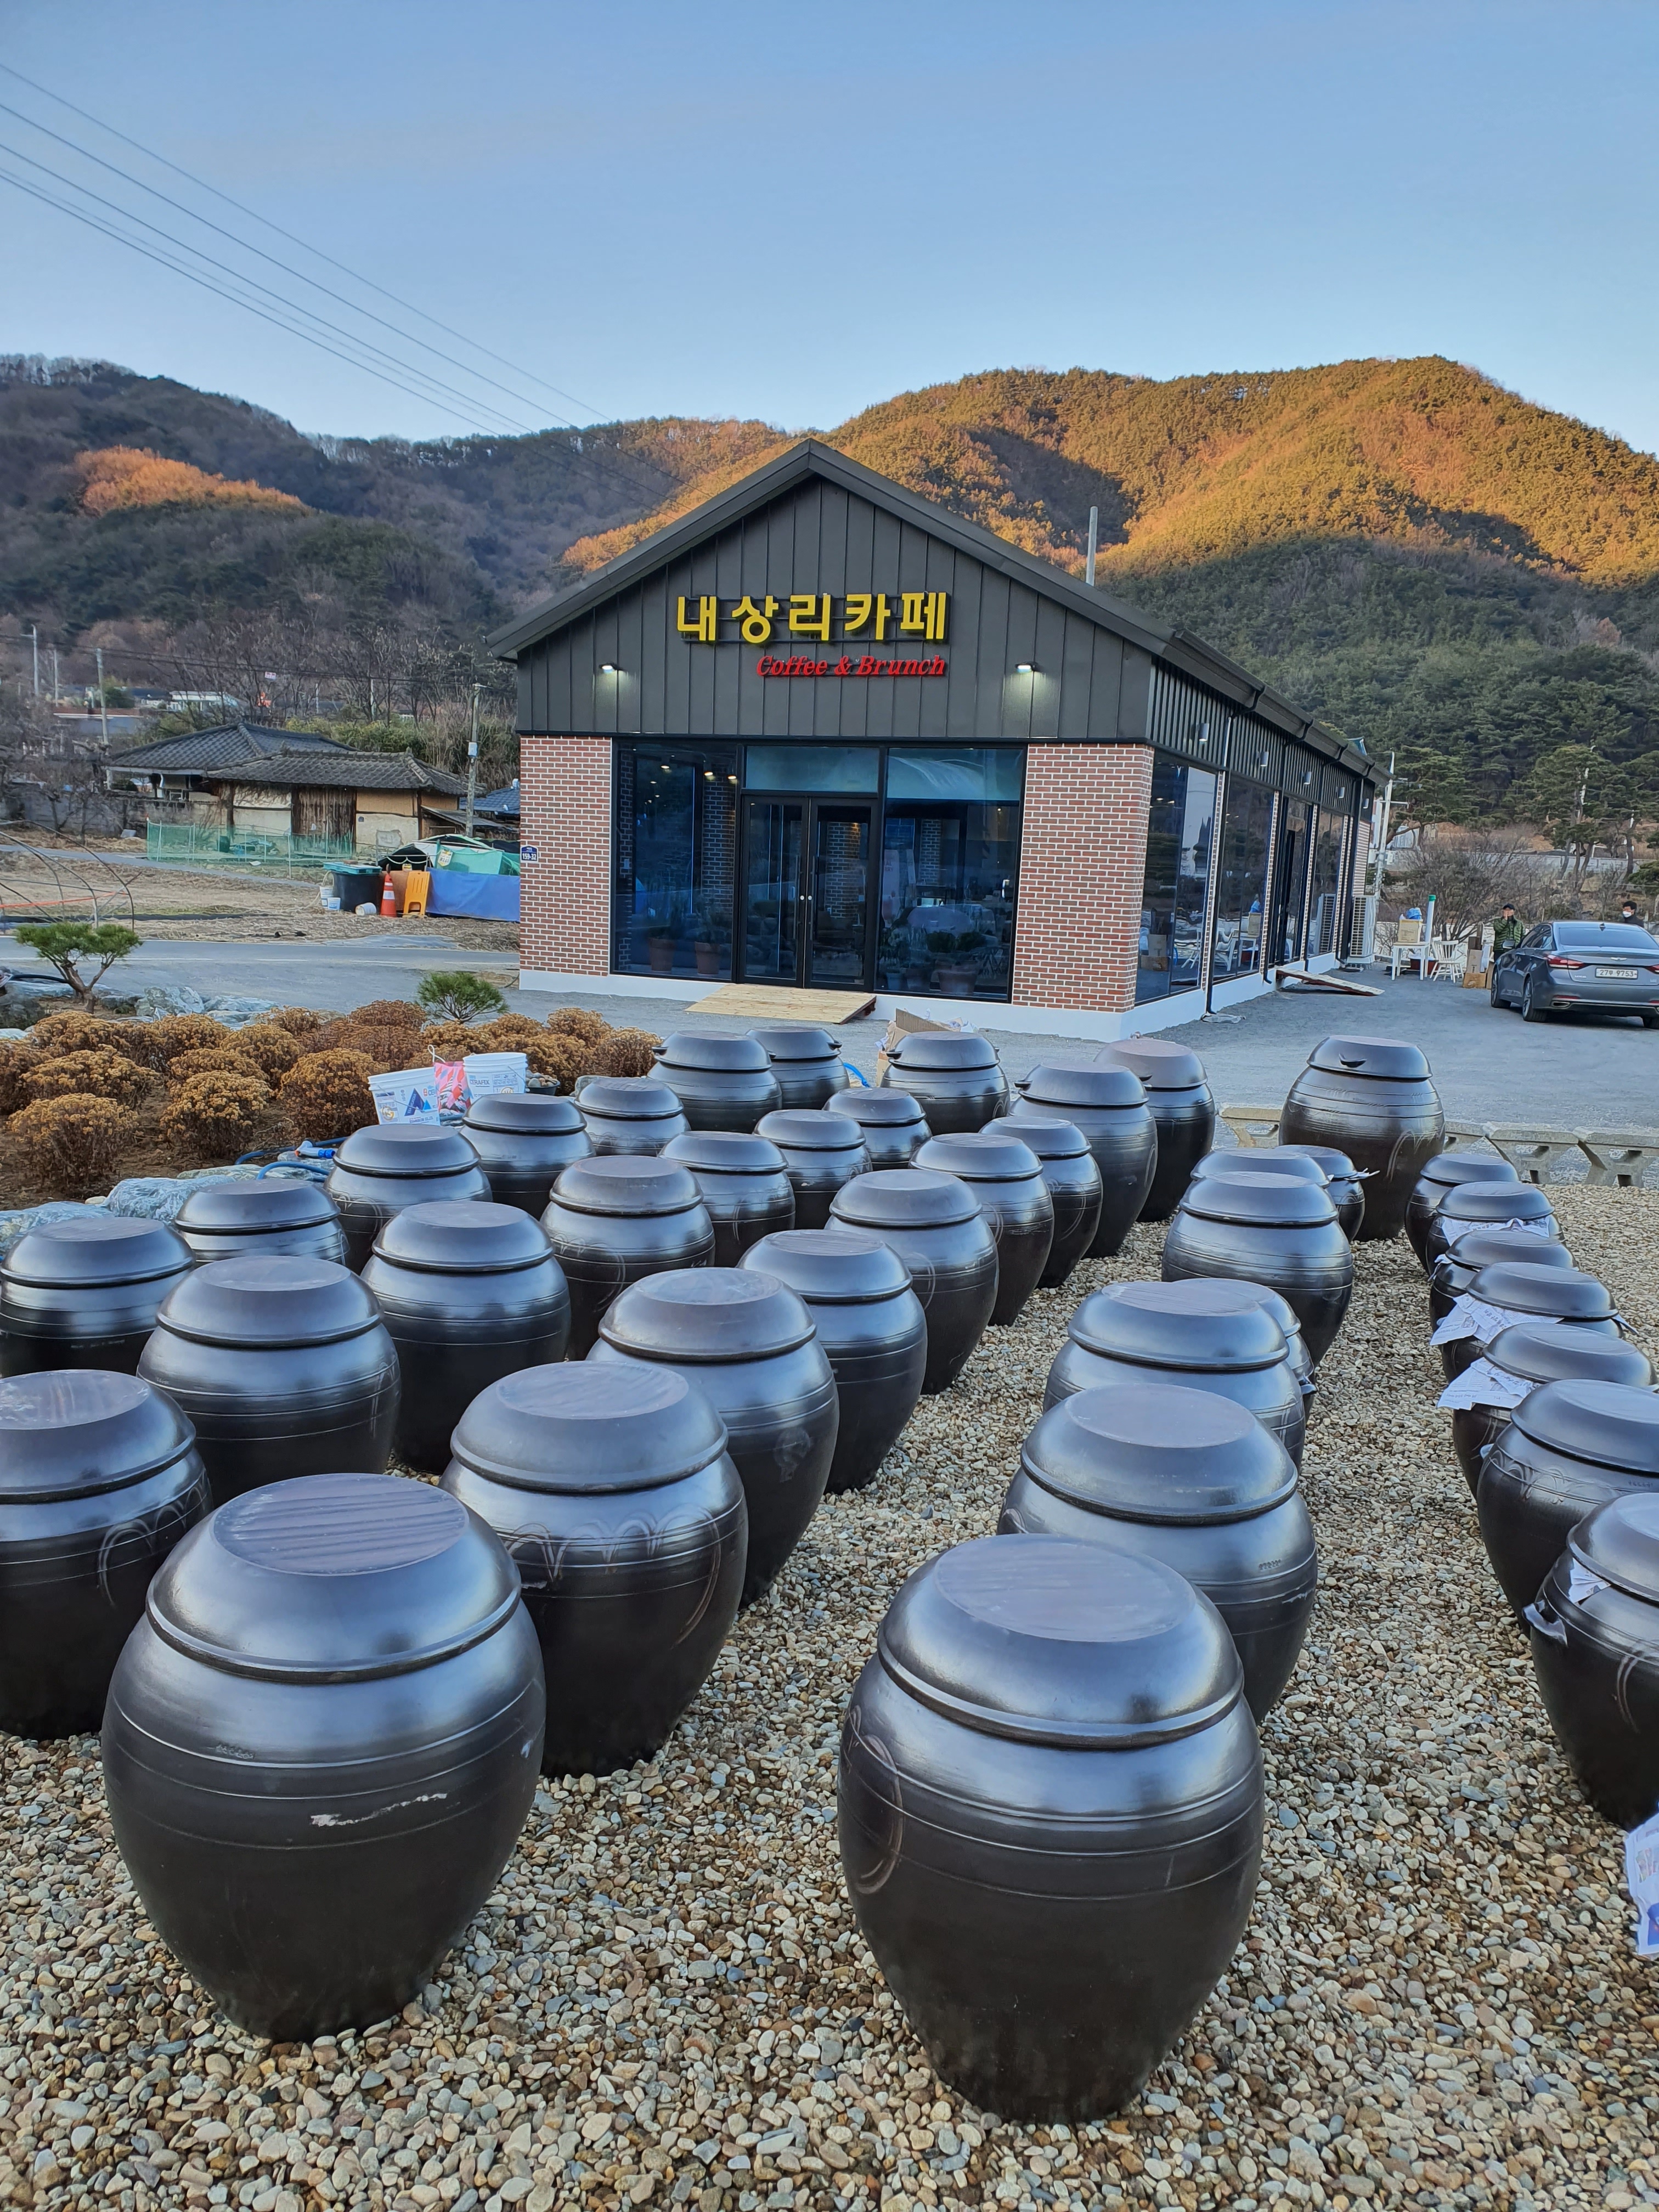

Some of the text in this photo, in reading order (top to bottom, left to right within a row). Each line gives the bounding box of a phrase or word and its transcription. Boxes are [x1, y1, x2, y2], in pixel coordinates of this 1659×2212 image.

[677, 591, 947, 644] 내상리카페
[757, 654, 945, 676] Coffee & Brunch
[522, 853, 537, 861] 159-32
